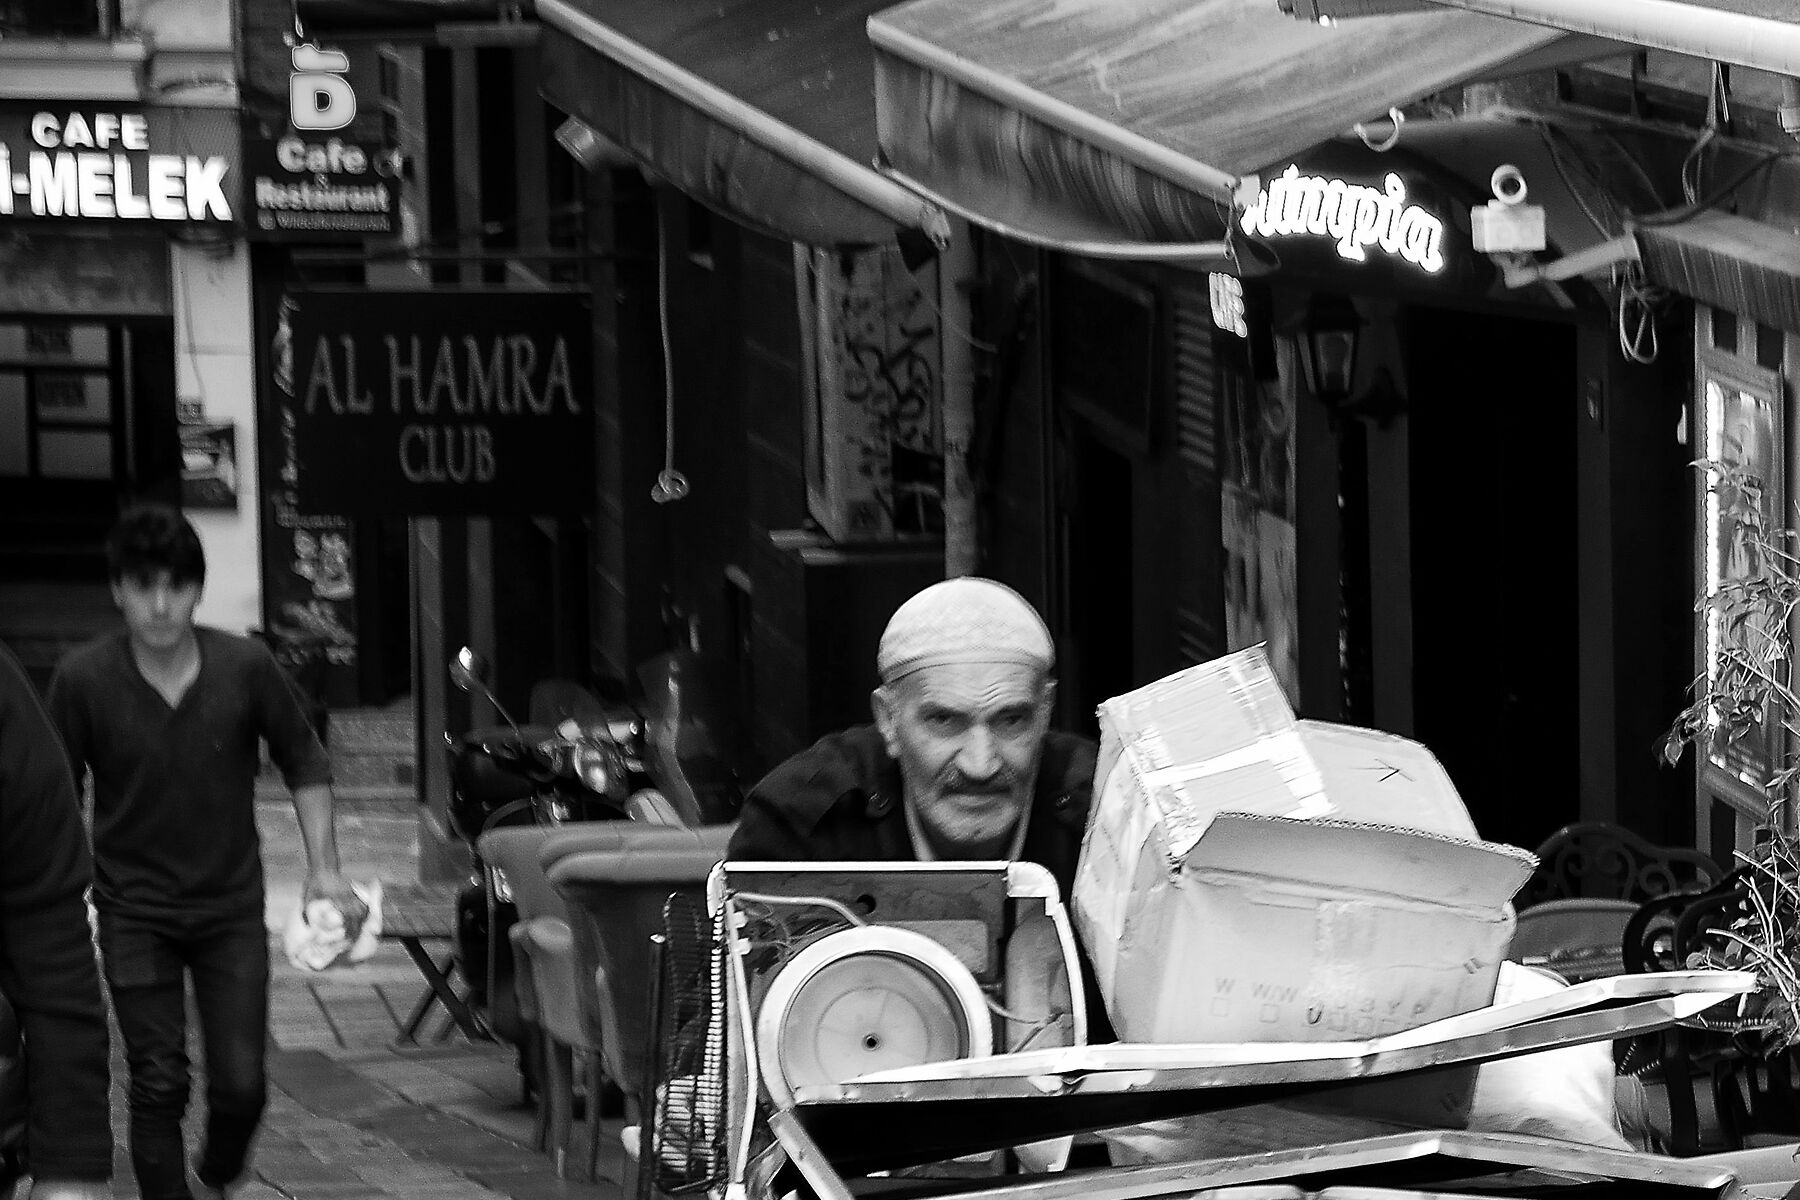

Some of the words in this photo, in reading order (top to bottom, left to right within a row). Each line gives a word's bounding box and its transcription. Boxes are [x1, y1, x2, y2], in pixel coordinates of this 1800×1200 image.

[31, 111, 149, 150] CAFE
[276, 136, 368, 175] Cafe
[305, 334, 374, 415] AL
[383, 334, 580, 415] HAMRA
[398, 424, 496, 484] CLUB
